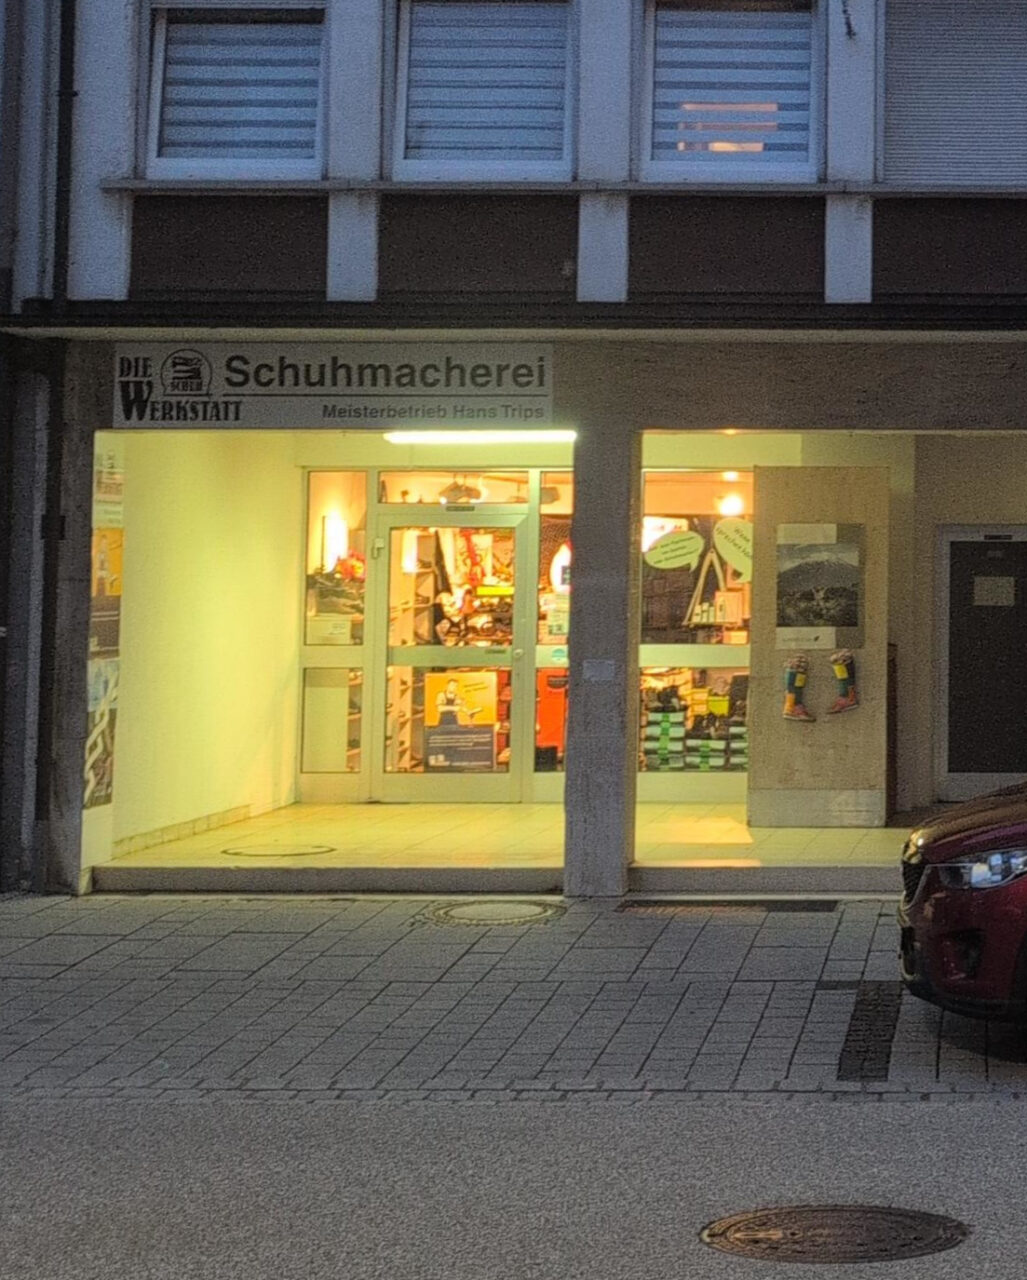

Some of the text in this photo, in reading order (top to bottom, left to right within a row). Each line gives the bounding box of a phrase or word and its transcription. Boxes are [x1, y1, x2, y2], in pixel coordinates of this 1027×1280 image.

[118, 356, 153, 378] DIE
[224, 355, 546, 389] Schuhmacherei
[118, 379, 242, 421] WERKSTATT
[322, 403, 545, 421] Meisterbetrieb Hans Trips
